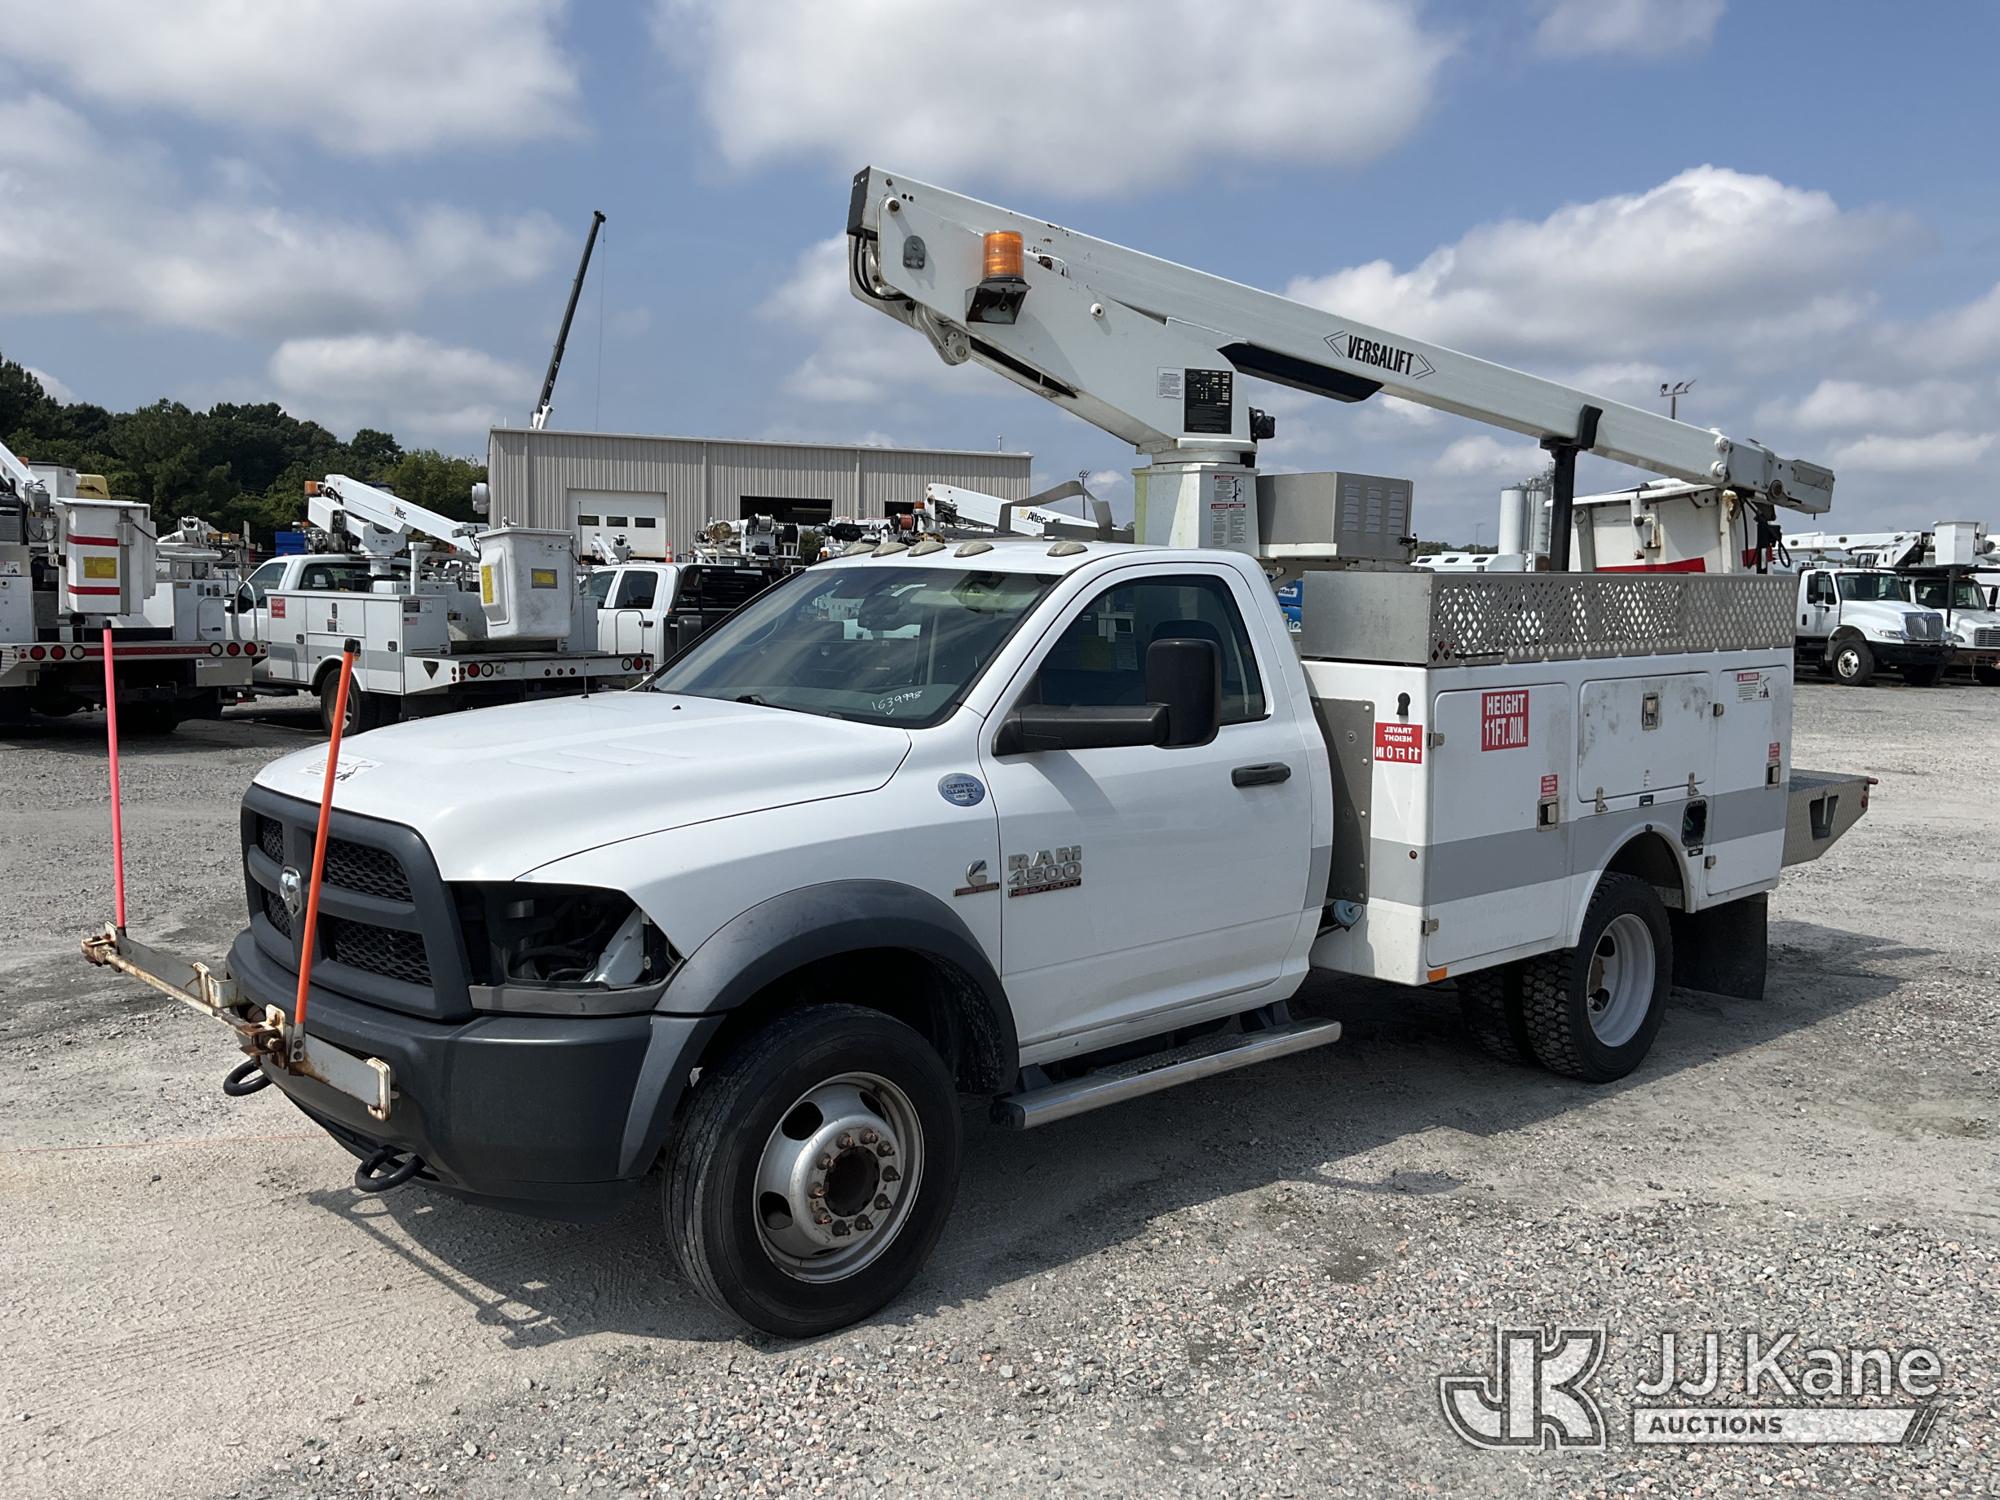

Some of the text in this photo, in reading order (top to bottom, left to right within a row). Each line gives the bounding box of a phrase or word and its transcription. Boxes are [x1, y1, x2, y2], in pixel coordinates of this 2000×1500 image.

[1347, 335, 1414, 375] VERSALIFT
[1026, 511, 1047, 524] Altec
[871, 689, 923, 711] 1639998
[1486, 694, 1525, 716] HEIGHT
[1008, 845, 1082, 871] RAM
[1007, 861, 1082, 886] 4500
